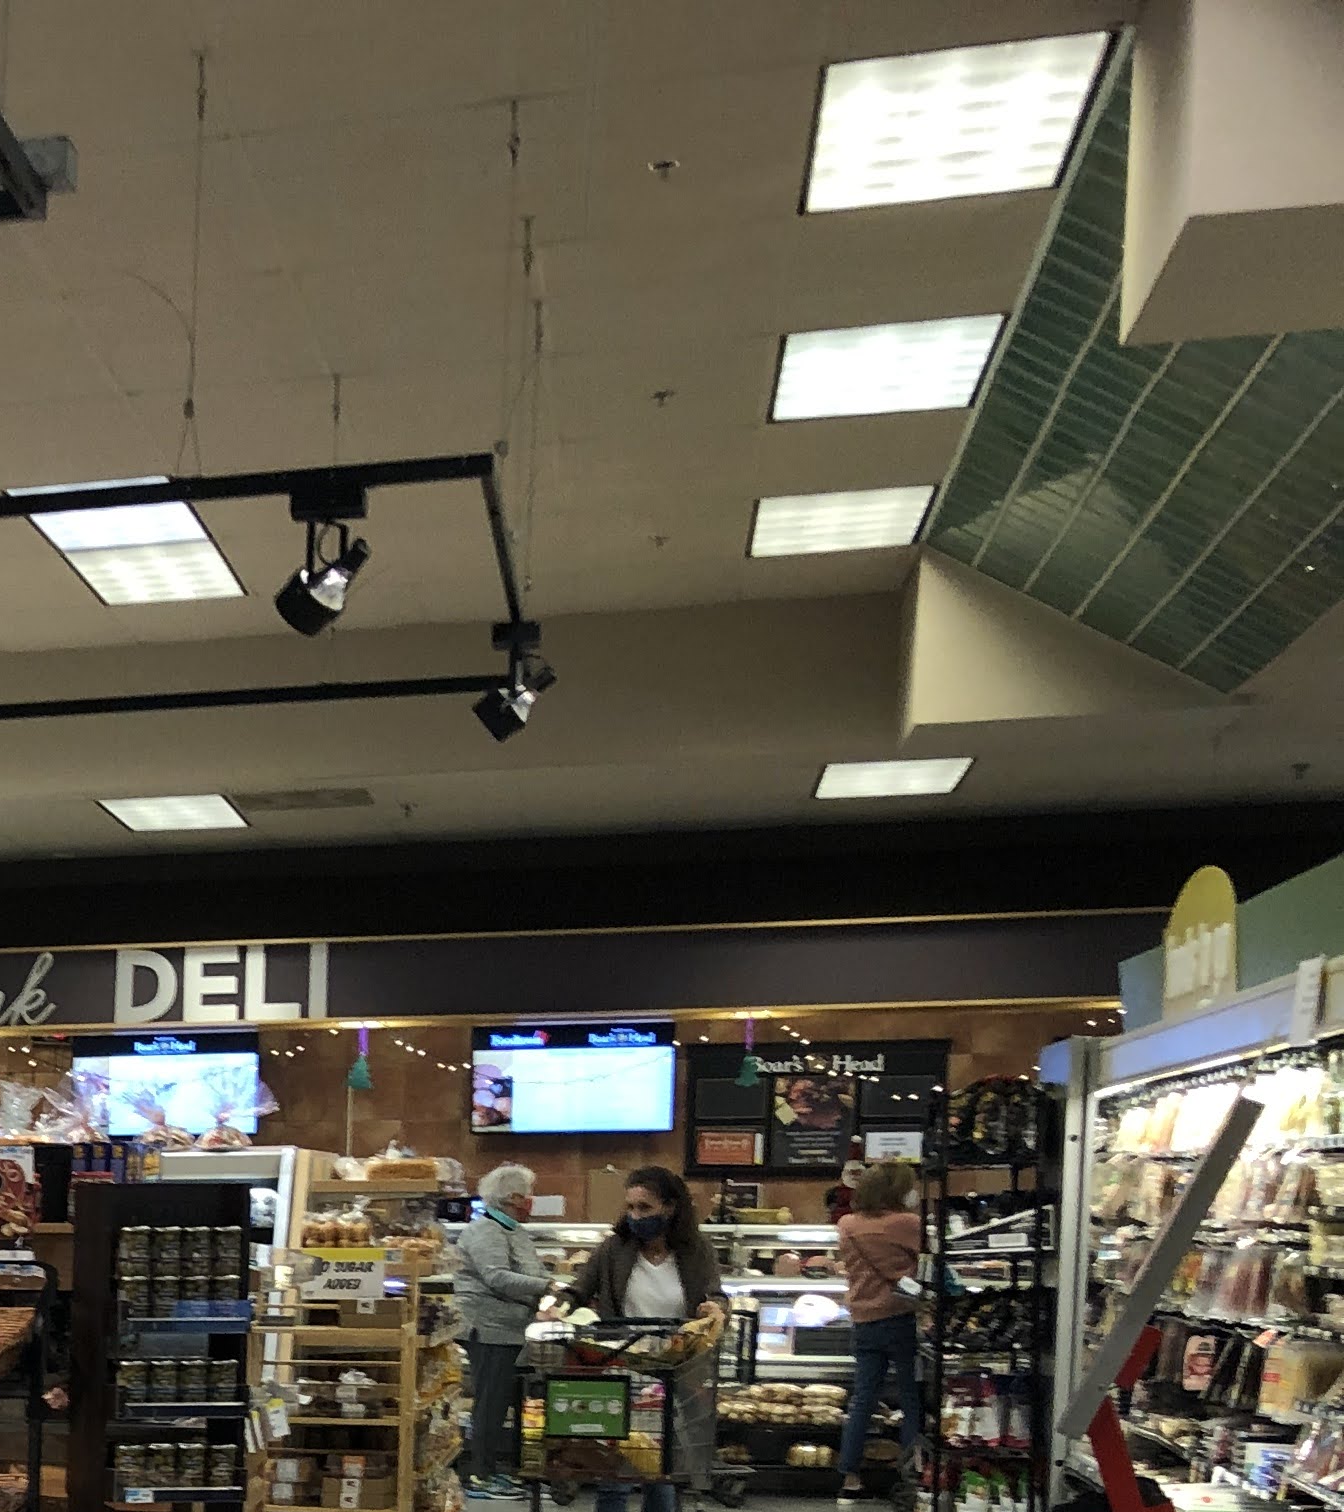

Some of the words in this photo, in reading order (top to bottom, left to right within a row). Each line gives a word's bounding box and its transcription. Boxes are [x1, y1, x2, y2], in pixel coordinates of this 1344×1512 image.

[113, 942, 330, 1024] DELI
[832, 1053, 886, 1073] Head
[334, 1261, 374, 1272] SUGAR
